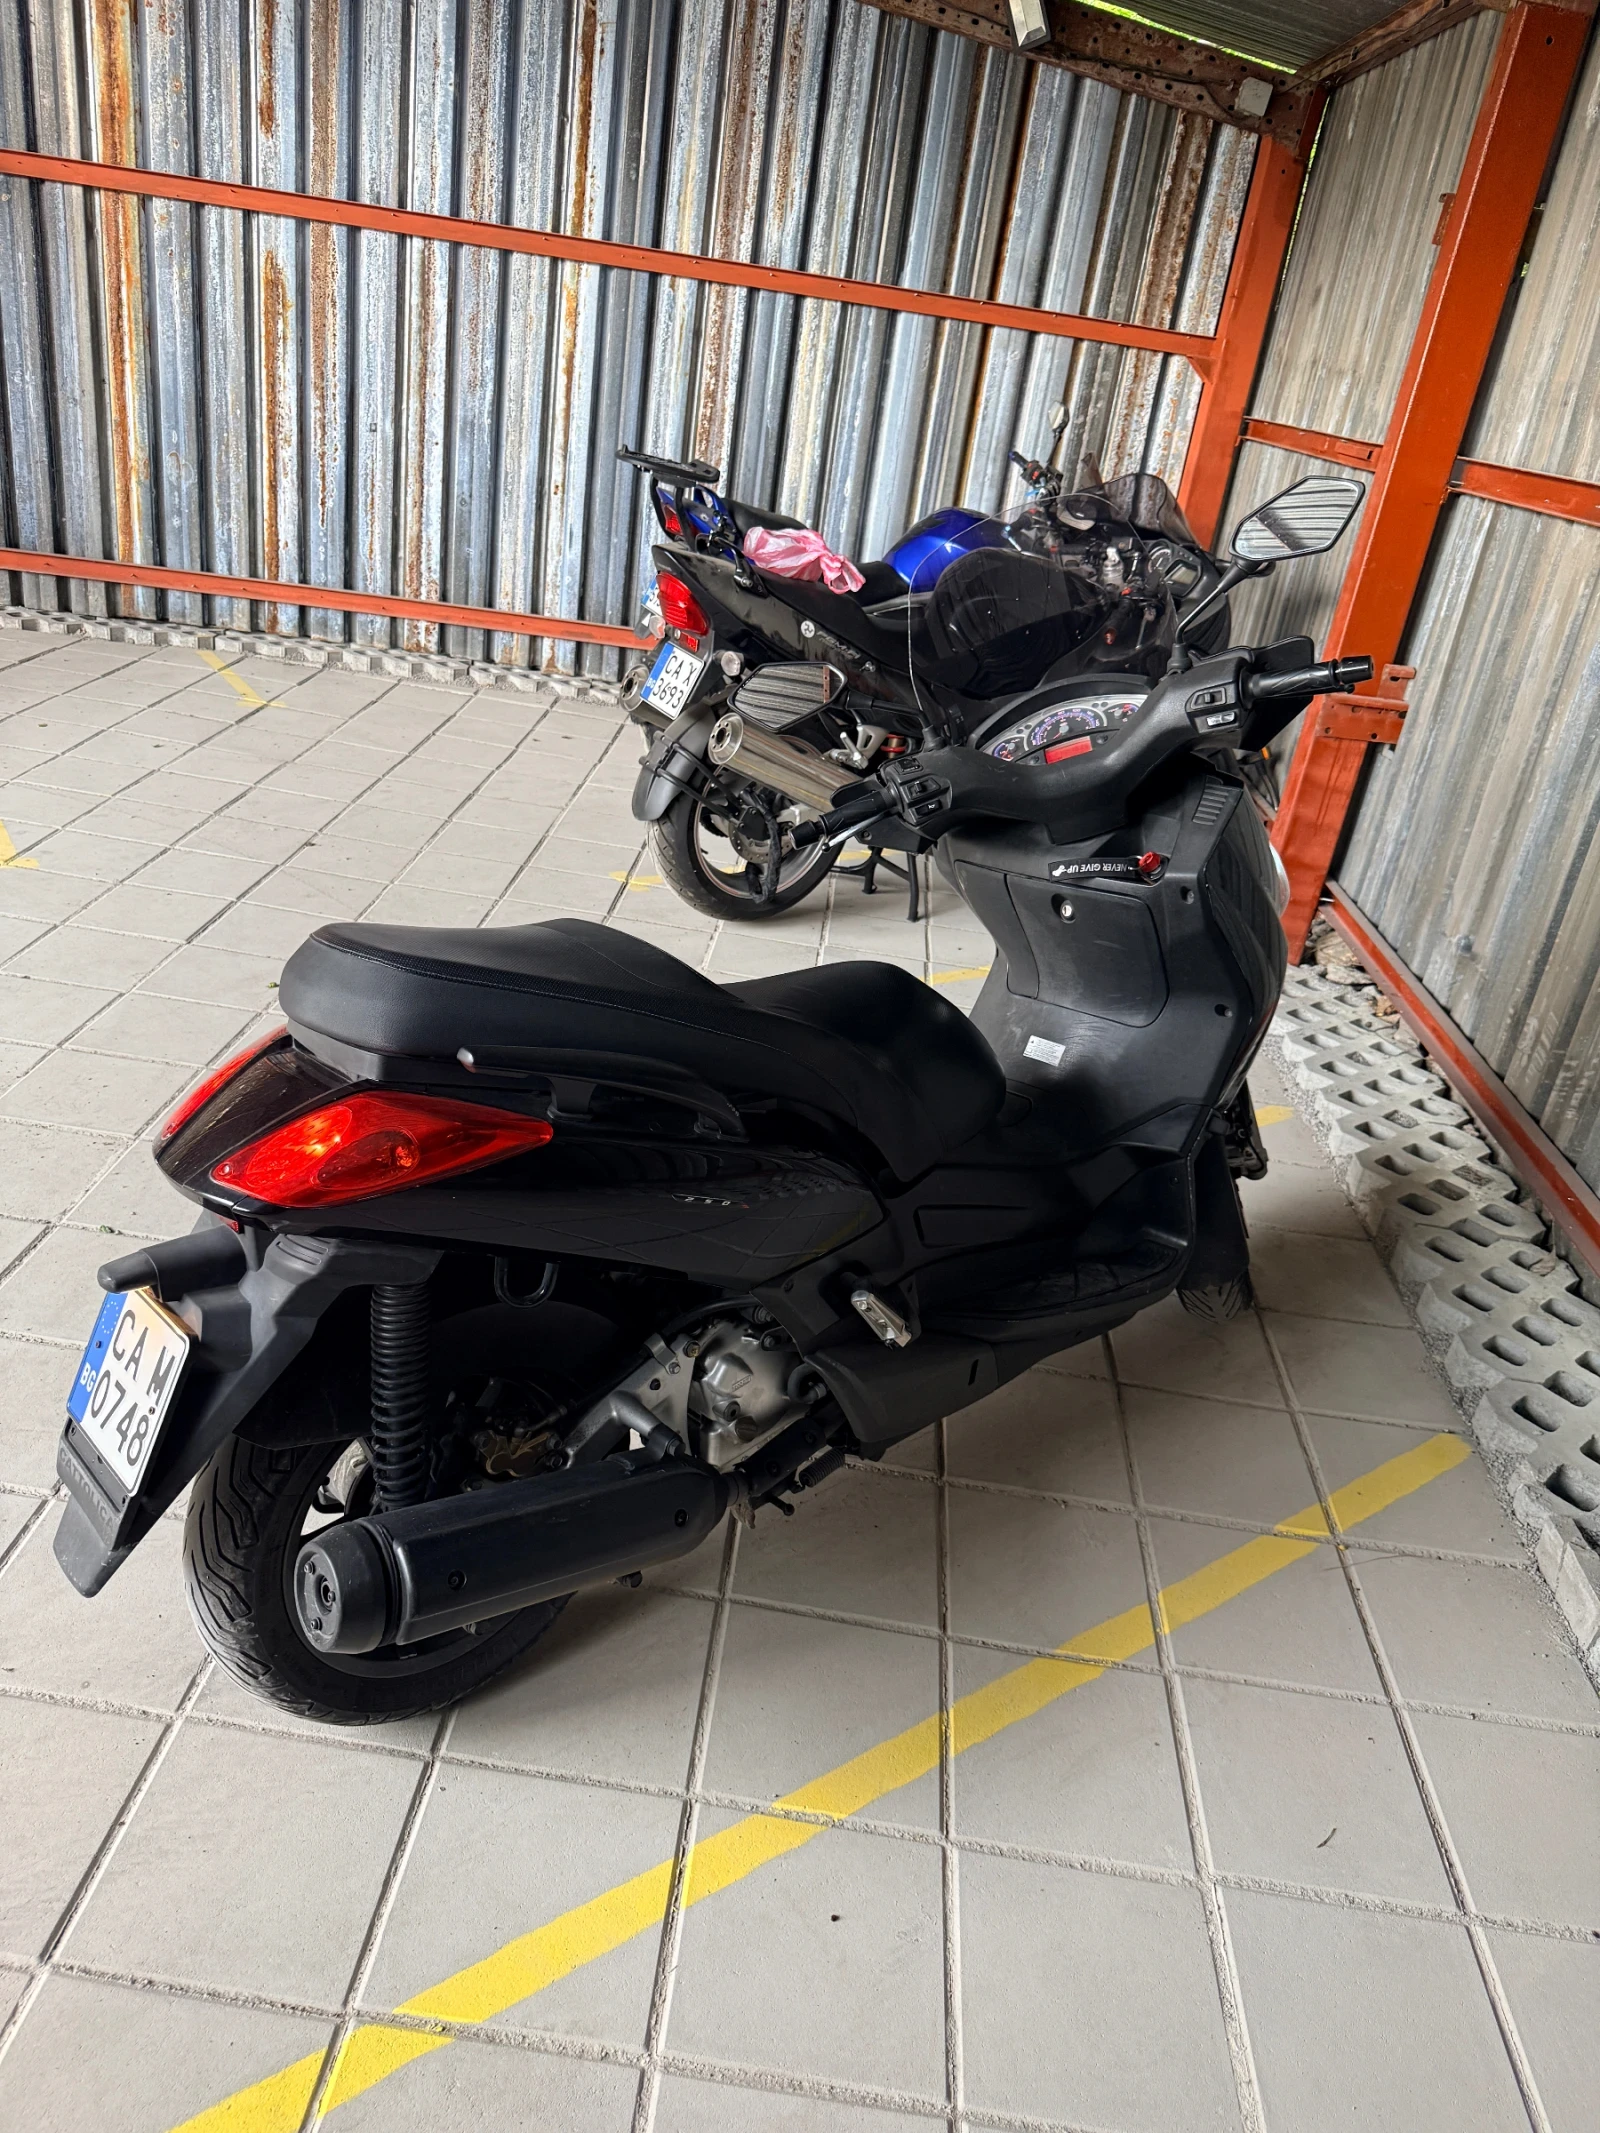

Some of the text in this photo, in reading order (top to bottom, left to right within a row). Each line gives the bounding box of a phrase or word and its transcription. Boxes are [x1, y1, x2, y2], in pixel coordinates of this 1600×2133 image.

[665, 655, 697, 687] CA X
[652, 677, 684, 709] 3693
[1066, 862, 1128, 874] NEVER GIVE UP
[112, 1309, 176, 1407] CA M
[79, 1362, 97, 1392] BG
[90, 1369, 150, 1467] 0748
